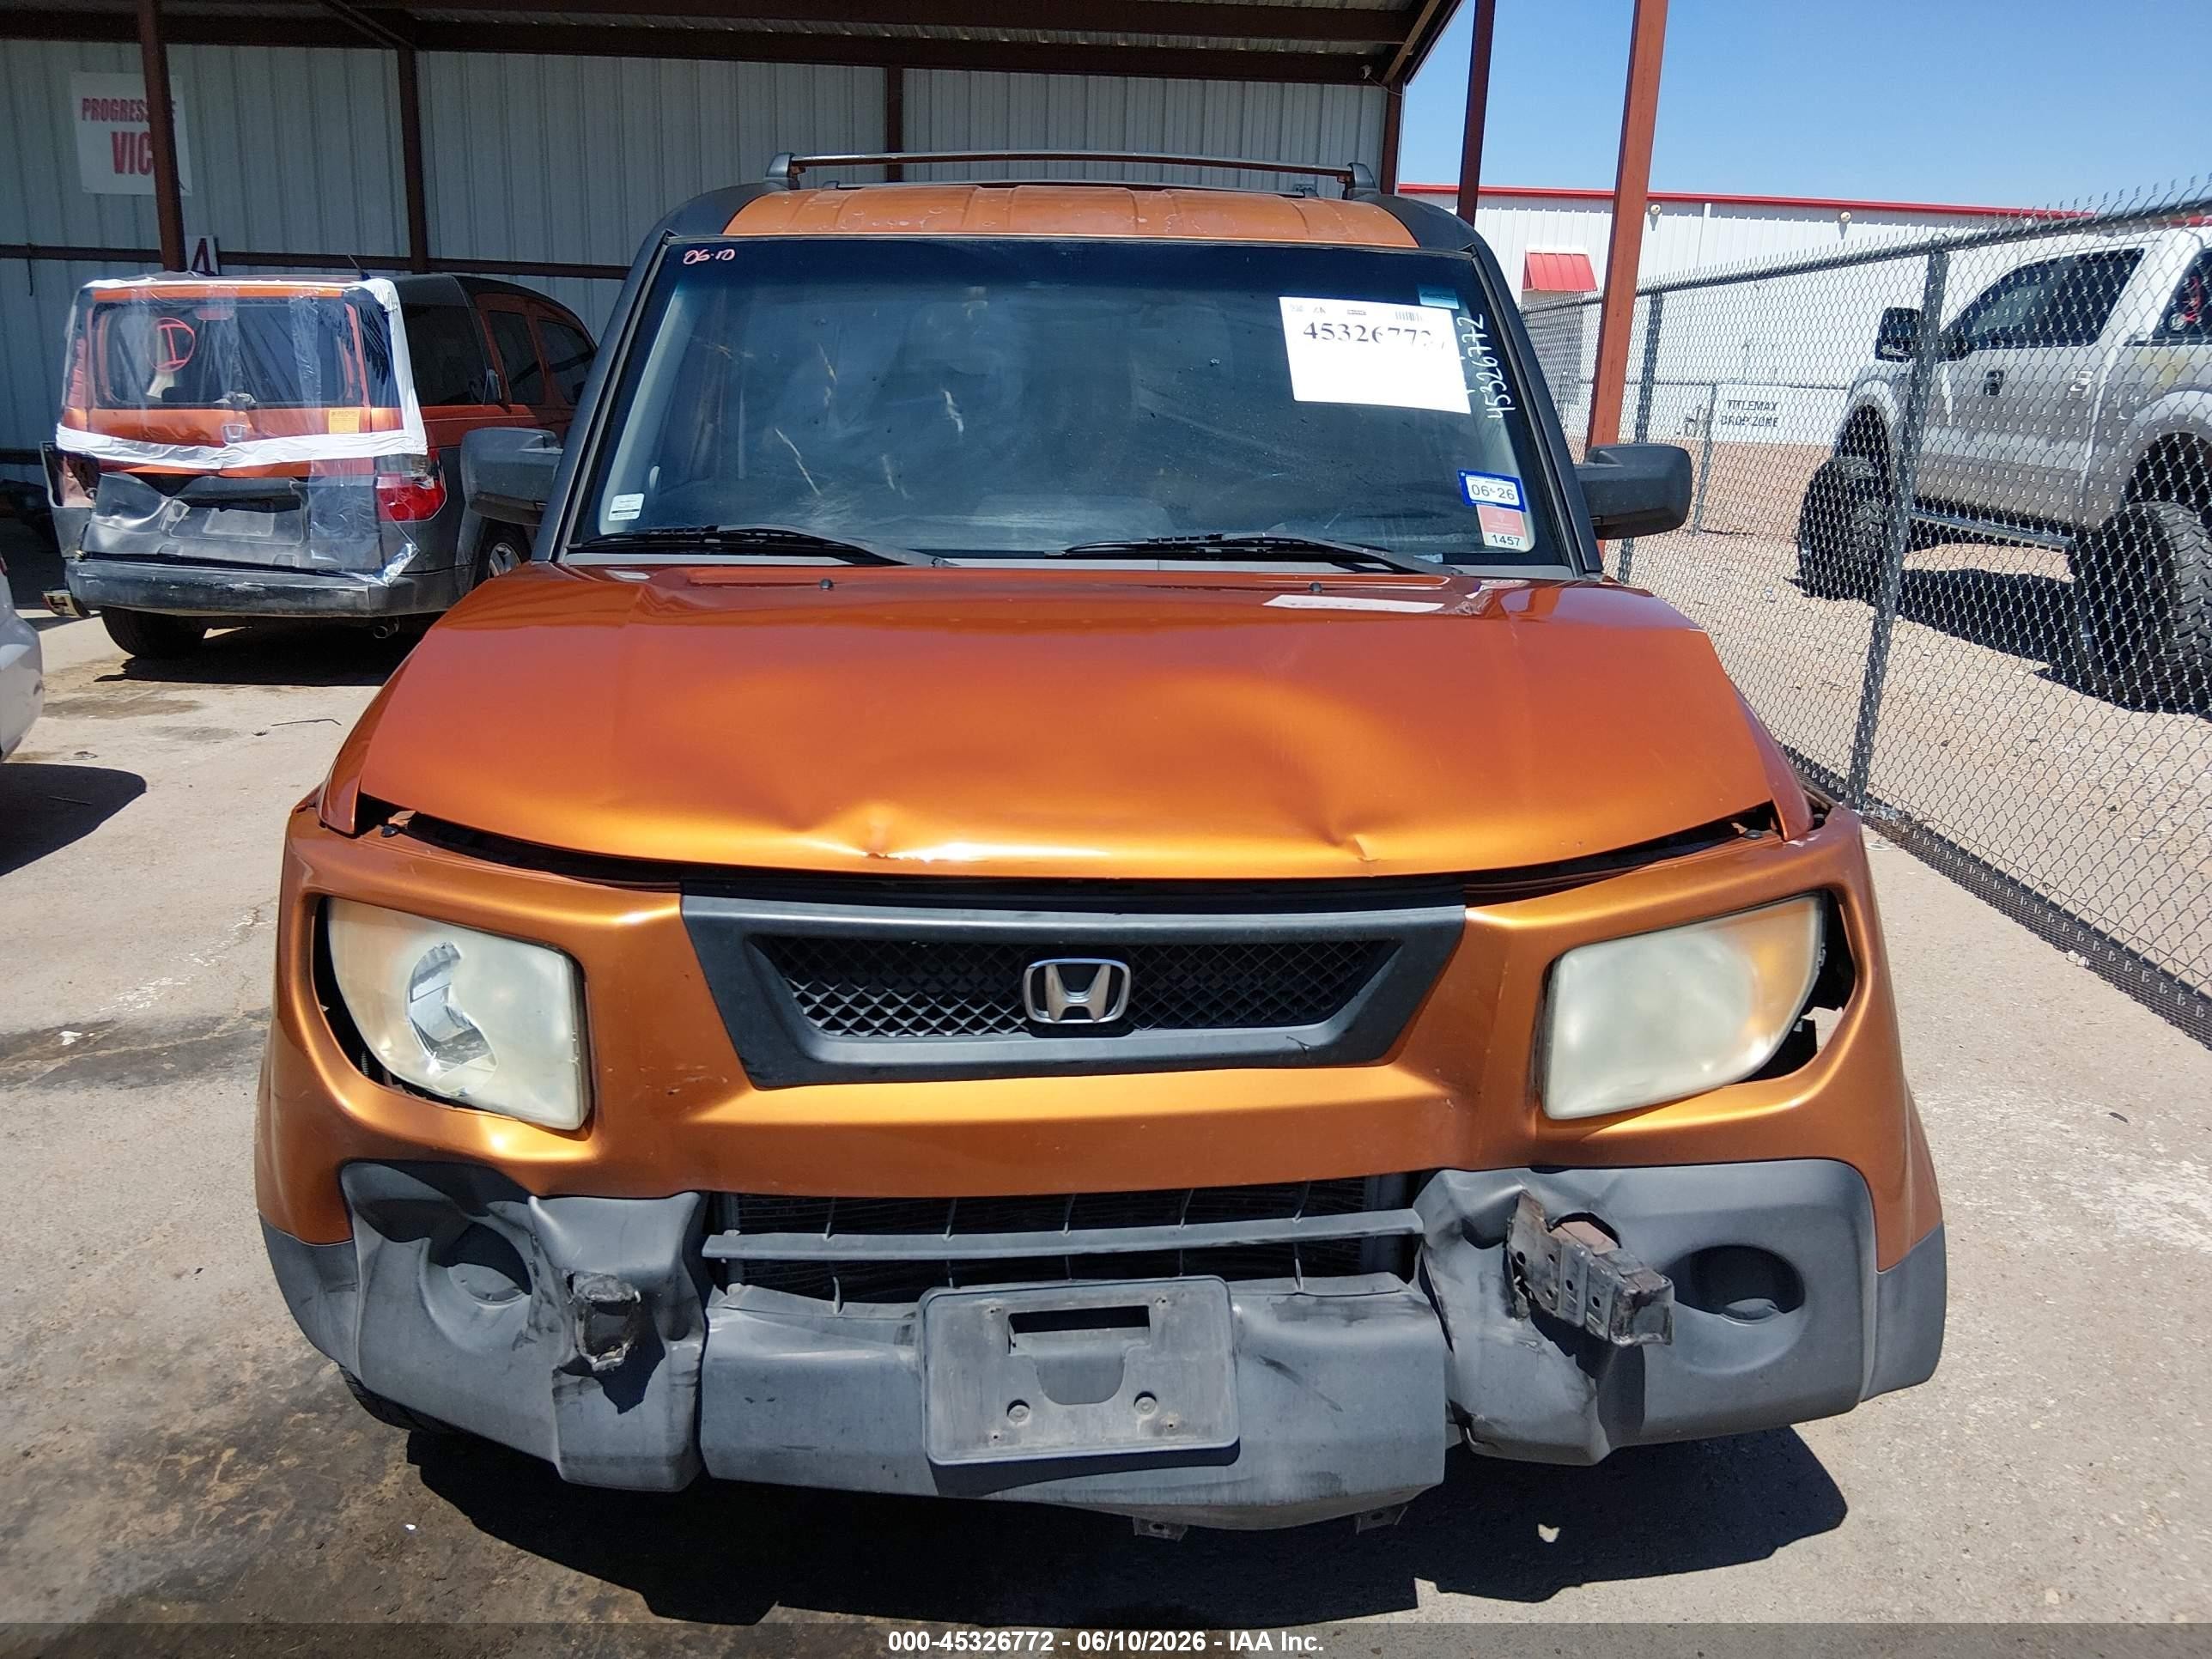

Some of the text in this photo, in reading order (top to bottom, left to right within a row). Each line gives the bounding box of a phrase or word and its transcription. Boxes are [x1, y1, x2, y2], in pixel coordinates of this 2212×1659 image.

[1456, 313, 1516, 419] 45326772
[1727, 399, 1779, 411] TITLEMAX
[1721, 415, 1779, 428] DROP ZONE
[1492, 534, 1520, 546] 1457
